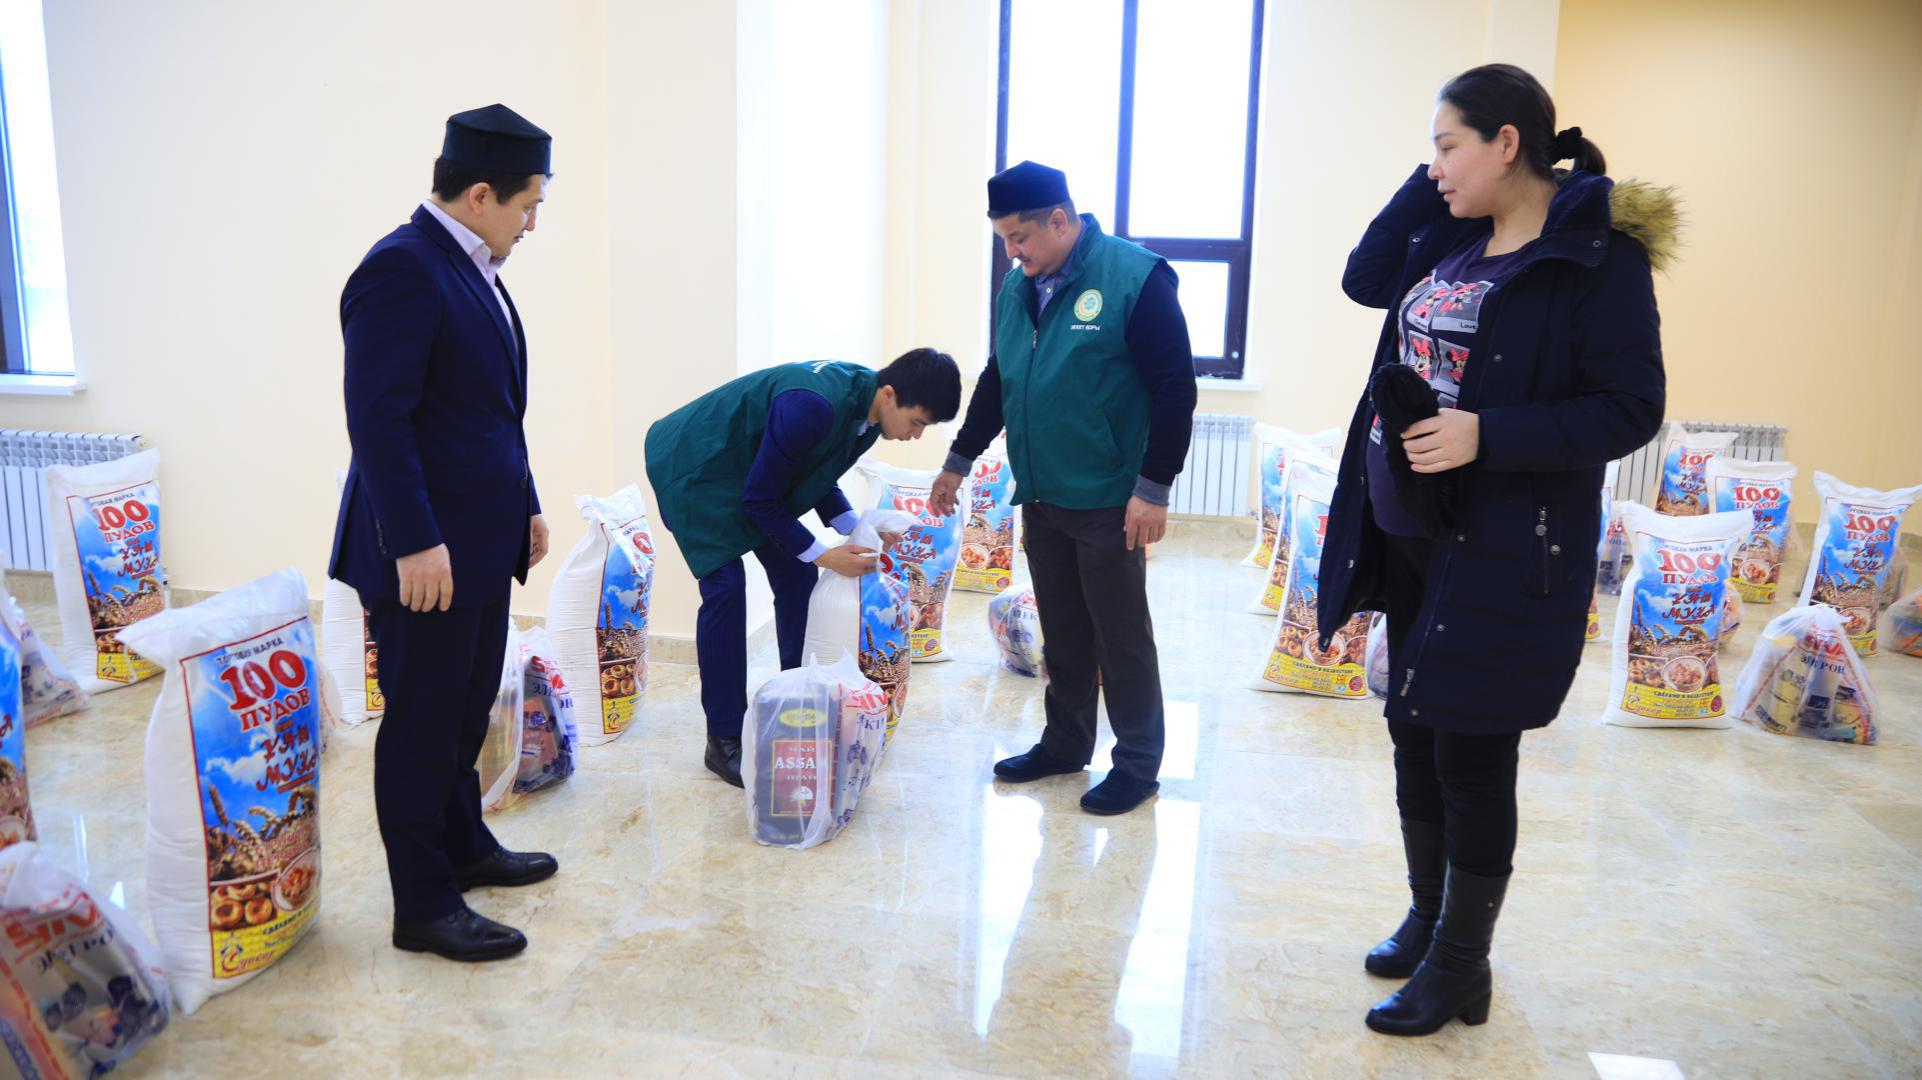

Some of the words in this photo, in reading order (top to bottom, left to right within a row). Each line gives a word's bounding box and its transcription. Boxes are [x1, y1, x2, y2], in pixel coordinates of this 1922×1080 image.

[1731, 486, 1780, 502] 100
[92, 499, 150, 531] 100
[1843, 512, 1896, 534] 100
[103, 520, 156, 544] ПУДОВ
[1656, 549, 1721, 574] 100
[1662, 573, 1718, 586] ПУДОВ
[252, 637, 284, 655] МАРКА
[220, 650, 306, 711] 100
[239, 687, 311, 732] ПУДОВ
[774, 756, 817, 769] ASSA
